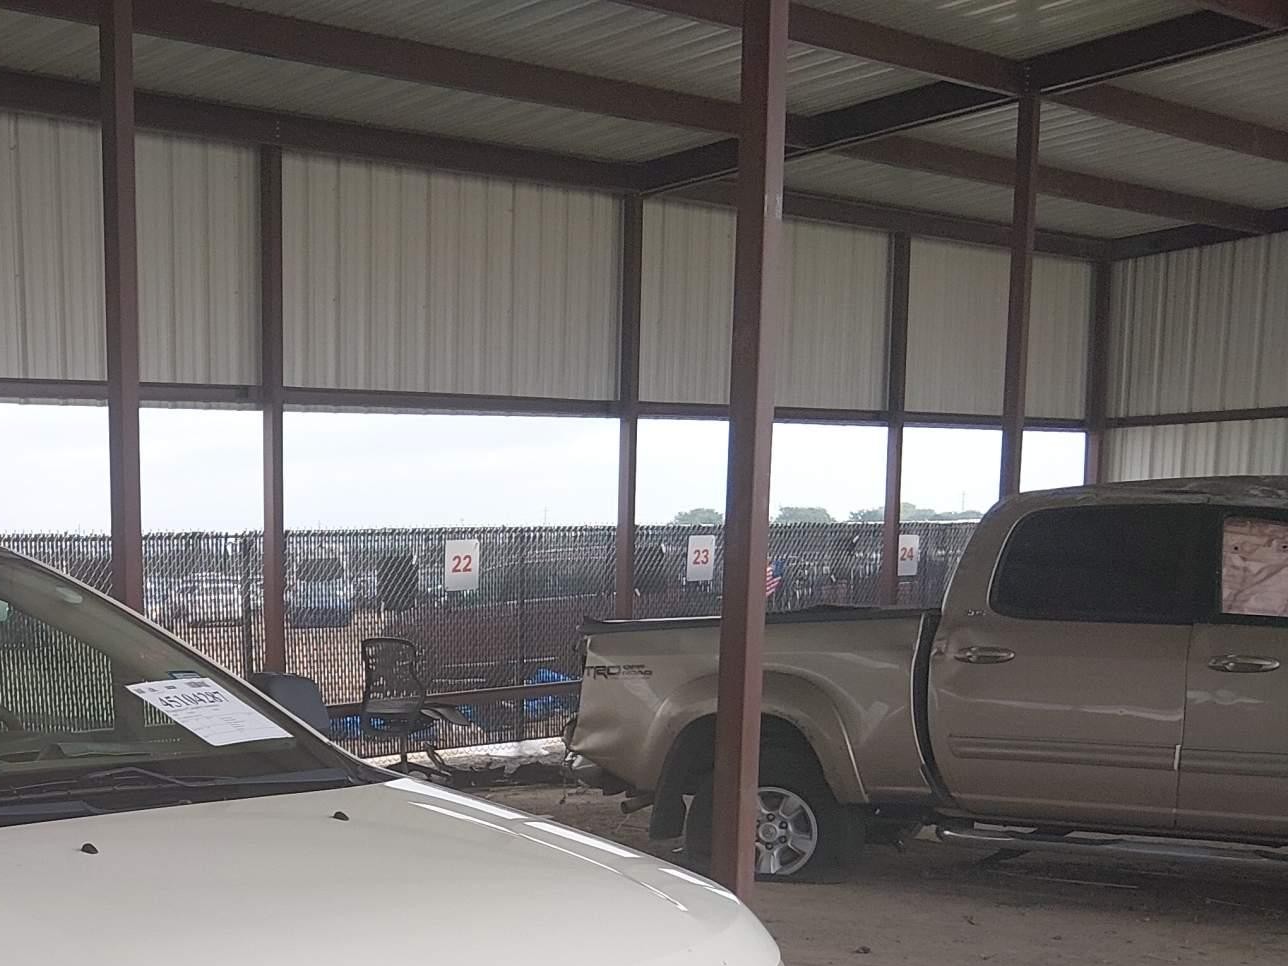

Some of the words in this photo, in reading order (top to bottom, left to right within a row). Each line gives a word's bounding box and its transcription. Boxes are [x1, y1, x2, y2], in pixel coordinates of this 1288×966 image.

[692, 549, 710, 565] 23
[899, 547, 914, 561] 24
[452, 555, 472, 573] 22
[585, 665, 621, 680] TRD
[158, 690, 230, 709] 45104287
